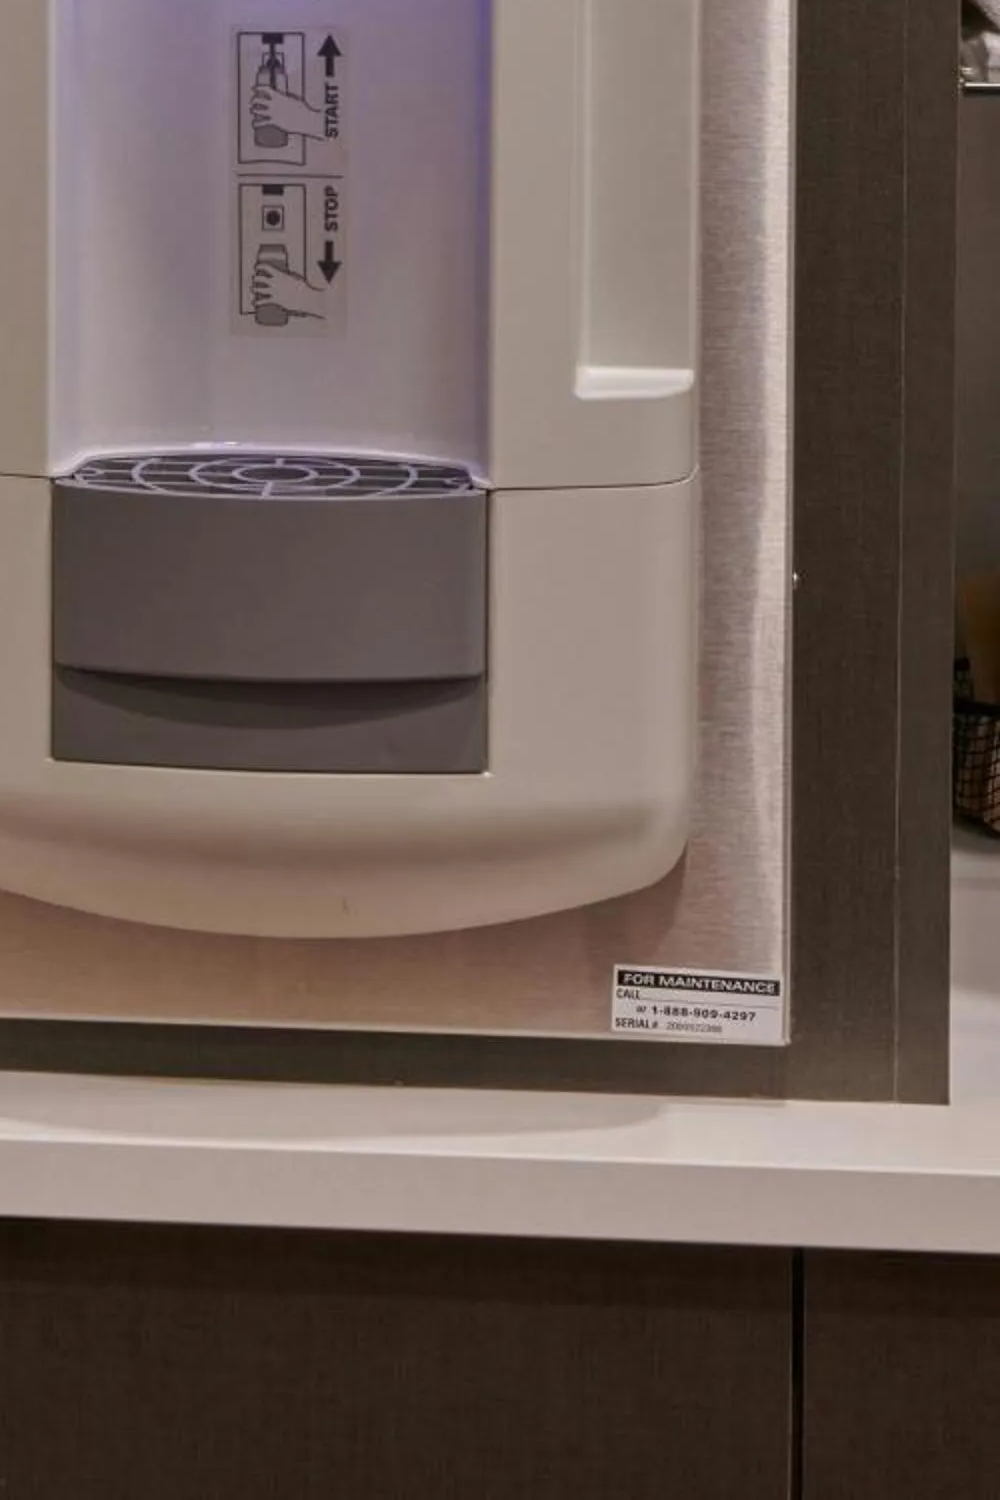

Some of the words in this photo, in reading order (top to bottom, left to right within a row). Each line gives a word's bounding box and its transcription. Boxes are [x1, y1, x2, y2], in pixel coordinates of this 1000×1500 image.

[324, 82, 339, 139] START
[323, 185, 339, 232] STOP
[616, 988, 640, 1000] CALL
[624, 972, 654, 986] FOR
[658, 975, 776, 994] MAINTENANCE
[652, 1004, 757, 1022] 1-888-909-4297
